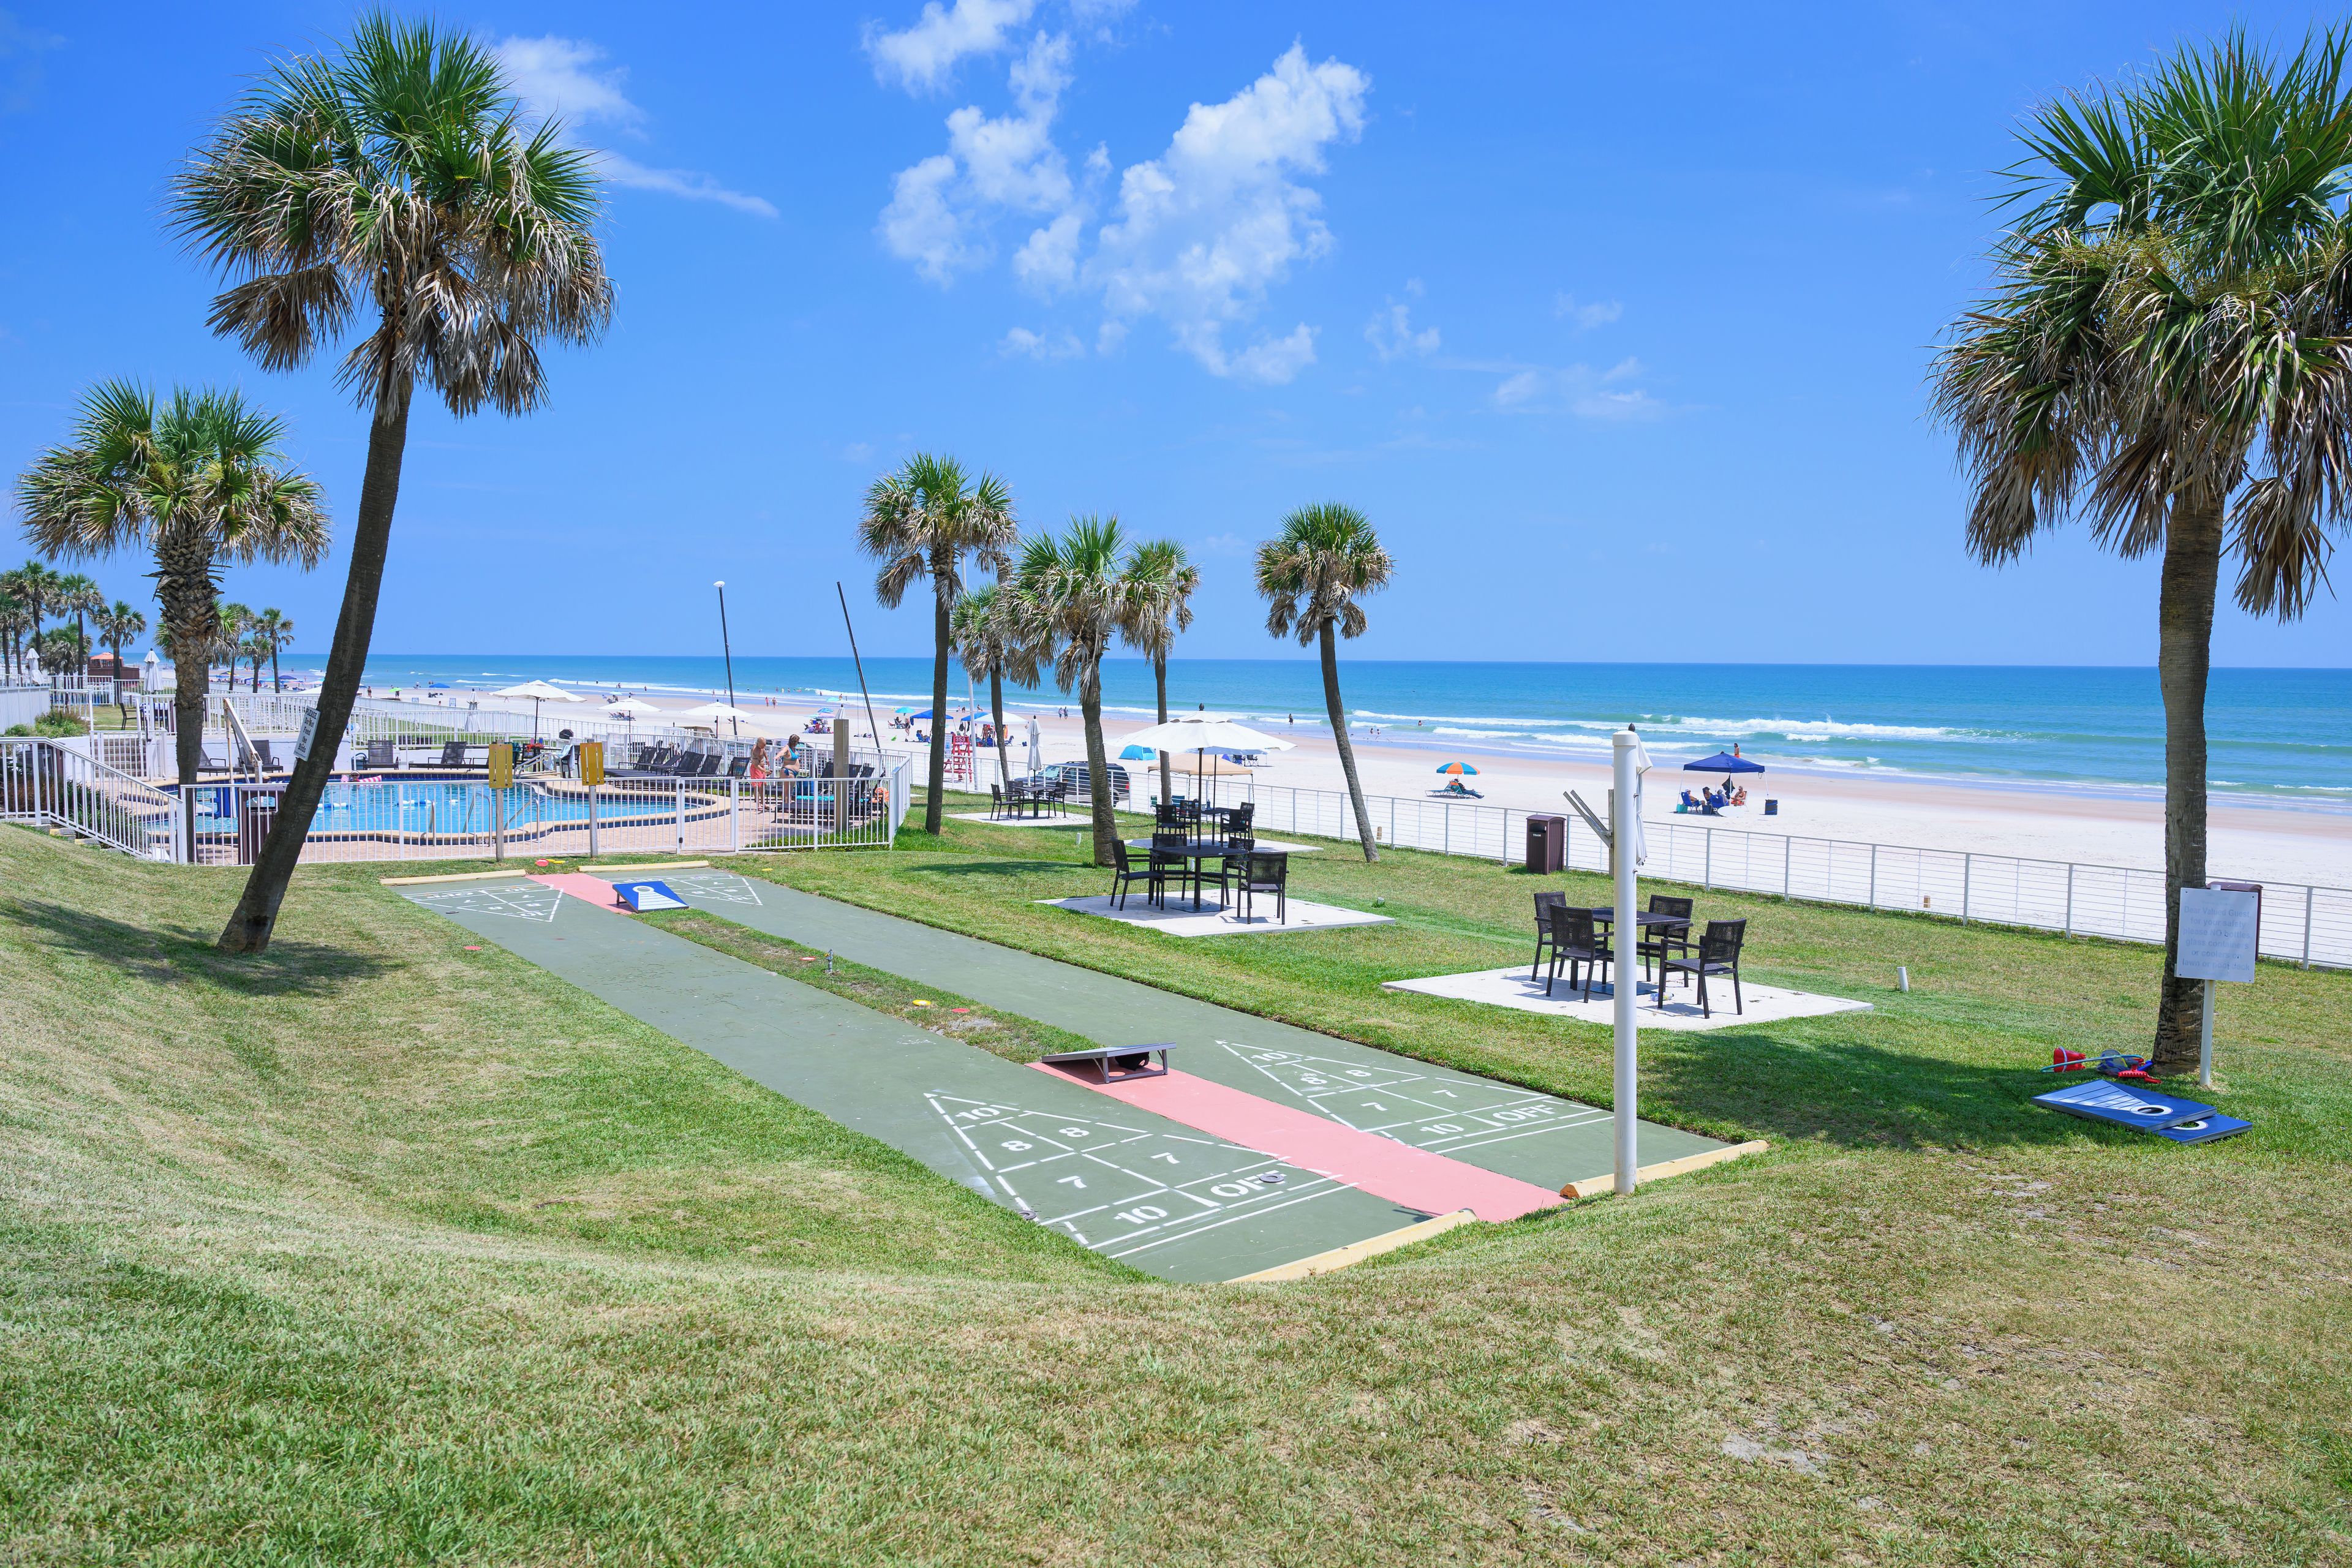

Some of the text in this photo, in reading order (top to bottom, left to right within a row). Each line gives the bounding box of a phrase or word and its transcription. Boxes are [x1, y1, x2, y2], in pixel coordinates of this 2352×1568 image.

[2202, 907, 2226, 916] Valued
[2223, 920, 2246, 929] safety
[2212, 961, 2230, 970] pool
[1250, 1052, 1288, 1061] 10
[1431, 1089, 1458, 1098] 7
[1360, 1102, 1388, 1111] 7
[956, 1107, 1000, 1120] 10
[1419, 1104, 1555, 1134] 10 OFF
[1058, 1127, 1090, 1137] 8
[1001, 1140, 1033, 1151] 8
[1150, 1152, 1180, 1164] 7
[1057, 1175, 1087, 1188] 7
[1114, 1205, 1168, 1224] 10
